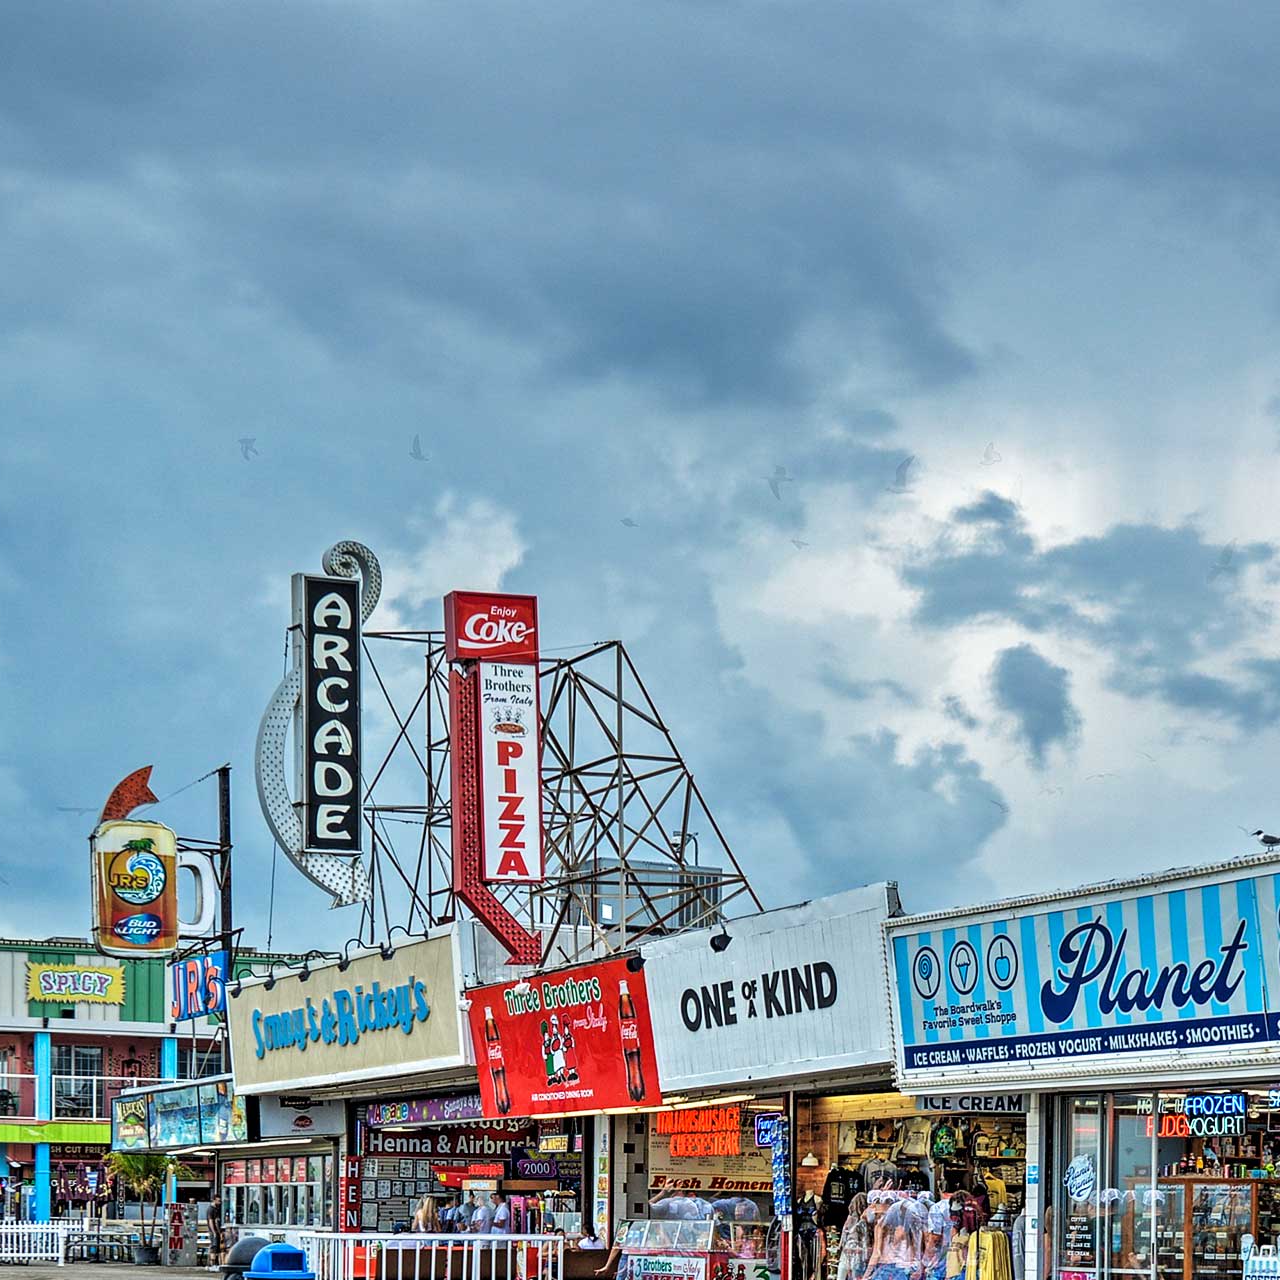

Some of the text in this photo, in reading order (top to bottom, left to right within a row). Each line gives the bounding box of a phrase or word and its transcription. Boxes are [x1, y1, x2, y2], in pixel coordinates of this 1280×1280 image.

[491, 606, 517, 618] Enjoy
[465, 613, 534, 643] Coke
[491, 664, 524, 678] Three
[484, 679, 532, 693] Brothers
[483, 693, 534, 706] From Italy
[313, 592, 353, 840] ARCADE
[497, 741, 530, 877] PIZZA
[122, 927, 160, 936] LIGHT
[127, 918, 157, 928] BUD
[1040, 915, 1248, 1024] Planet
[41, 972, 112, 996] SPICY
[503, 976, 602, 1016] Three Brothers
[680, 961, 838, 1032] ONE OF A KIND
[252, 975, 430, 1059] Sonny's & Rickey's
[933, 1000, 1002, 1017] The Boardwalk's
[922, 1012, 1017, 1030] Favorite Sweet Shoppe
[913, 1052, 928, 1066] ICE
[929, 1049, 961, 1066] CREAM
[966, 1045, 1010, 1061] WAFFLES
[1015, 1041, 1056, 1058] FROZEN
[1058, 1036, 1103, 1055] YOGURT
[1109, 1029, 1178, 1050] MILKSHAKES
[1185, 1022, 1255, 1044] SMOOTHIES
[373, 1102, 409, 1123] Arcade
[923, 1096, 1022, 1112] ICE CREAM
[1184, 1095, 1245, 1115] FROZEN
[655, 1106, 740, 1134] ITALIAN SAUSAGE
[1185, 1115, 1245, 1136] YOGURT
[85, 1146, 107, 1155] FRIES
[370, 1132, 432, 1153] Henna
[437, 1134, 451, 1154] &
[524, 1162, 550, 1176] 2000
[169, 1211, 184, 1250] ATM
[634, 1258, 642, 1278] 3
[642, 1258, 673, 1273] Brothers
